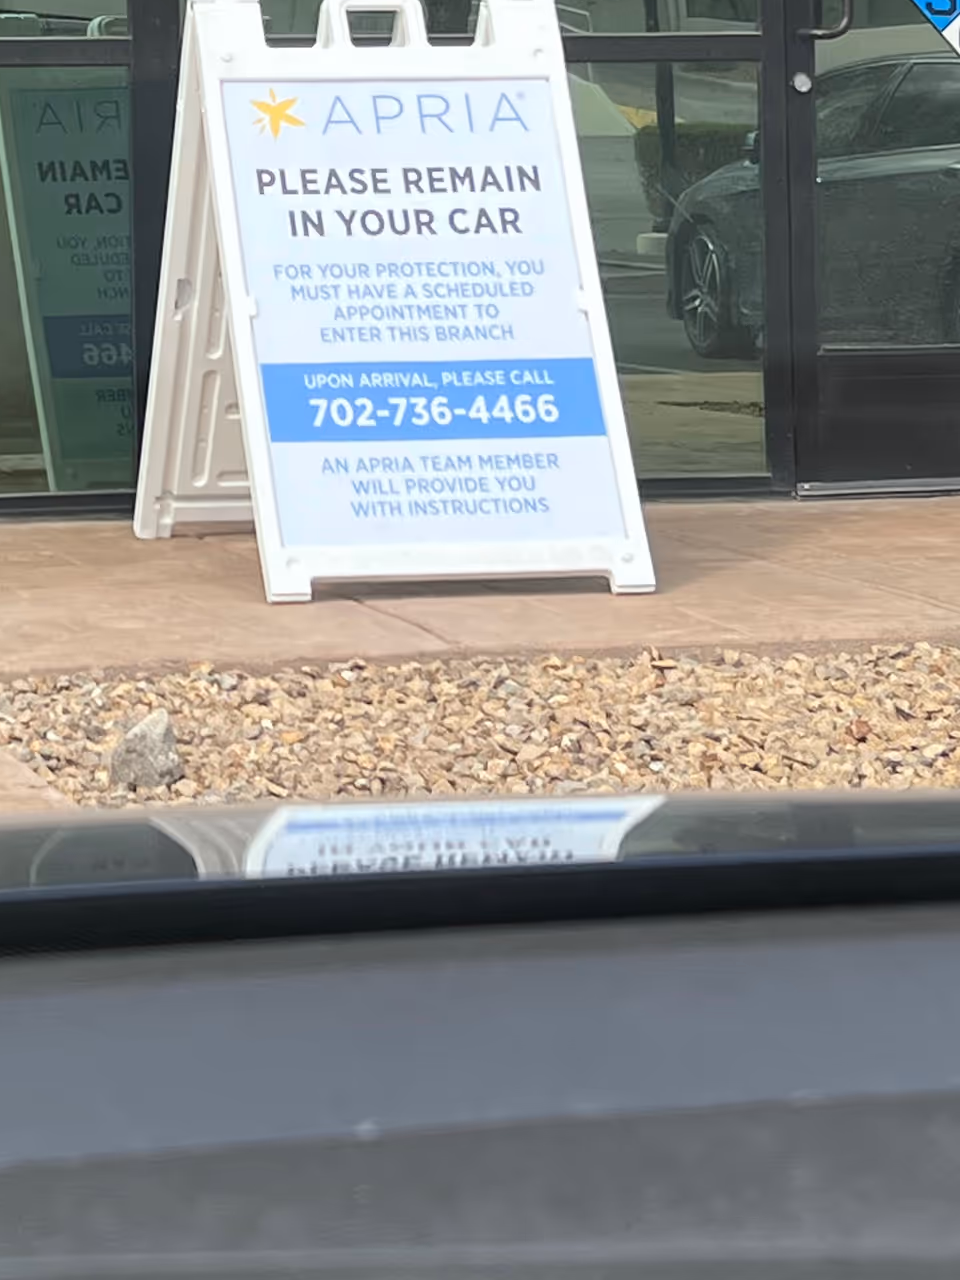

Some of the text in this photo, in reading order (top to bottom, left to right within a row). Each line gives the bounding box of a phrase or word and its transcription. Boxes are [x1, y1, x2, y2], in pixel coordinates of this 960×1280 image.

[321, 91, 530, 136] APRIA
[255, 165, 542, 196] PLEASE REMAIN
[288, 206, 523, 237] IN YOUR CAR
[272, 258, 546, 281] FOR YOUR PROTECTION, YOU
[290, 280, 535, 302] MUST HAVE A SCHEDULED
[334, 302, 500, 322] APPOINTMENT TO
[320, 323, 515, 344] ENTER THIS BRANCH
[303, 369, 554, 390] UPON ARRIVAL, PLEASE CALL
[309, 393, 559, 428] 702-736-4466
[321, 452, 560, 475] AN APRIA TEAM MEMBER
[351, 475, 536, 496] WILL PROVIDE YOU
[350, 497, 550, 518] WITH INSTRUCTIONS
